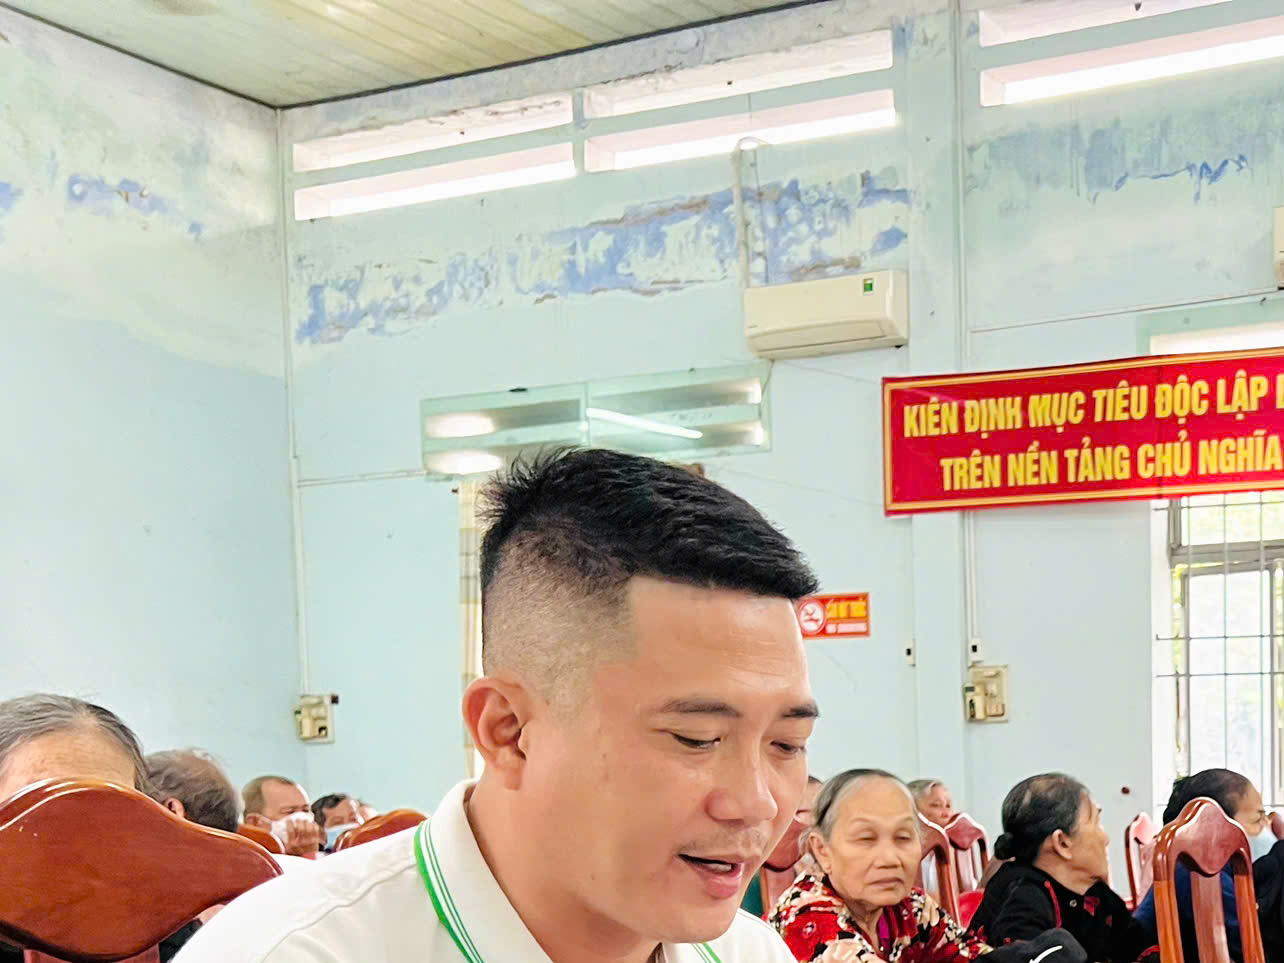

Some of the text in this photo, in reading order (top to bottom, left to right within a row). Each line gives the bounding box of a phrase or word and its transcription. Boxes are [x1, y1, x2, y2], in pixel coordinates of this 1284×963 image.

[903, 396, 959, 437] KIÊN
[964, 396, 1022, 438] ĐỊNH
[1029, 391, 1085, 433] MỤC
[1093, 380, 1147, 422] TIÊU
[1154, 374, 1209, 426] ĐỘC
[1216, 369, 1268, 424] LẬP
[941, 450, 1001, 491] TRÊN
[1007, 435, 1058, 486] NỀN
[1064, 436, 1130, 482] TẢNG
[1137, 430, 1190, 479] CHỦ
[1198, 429, 1282, 473] NGHĨA
